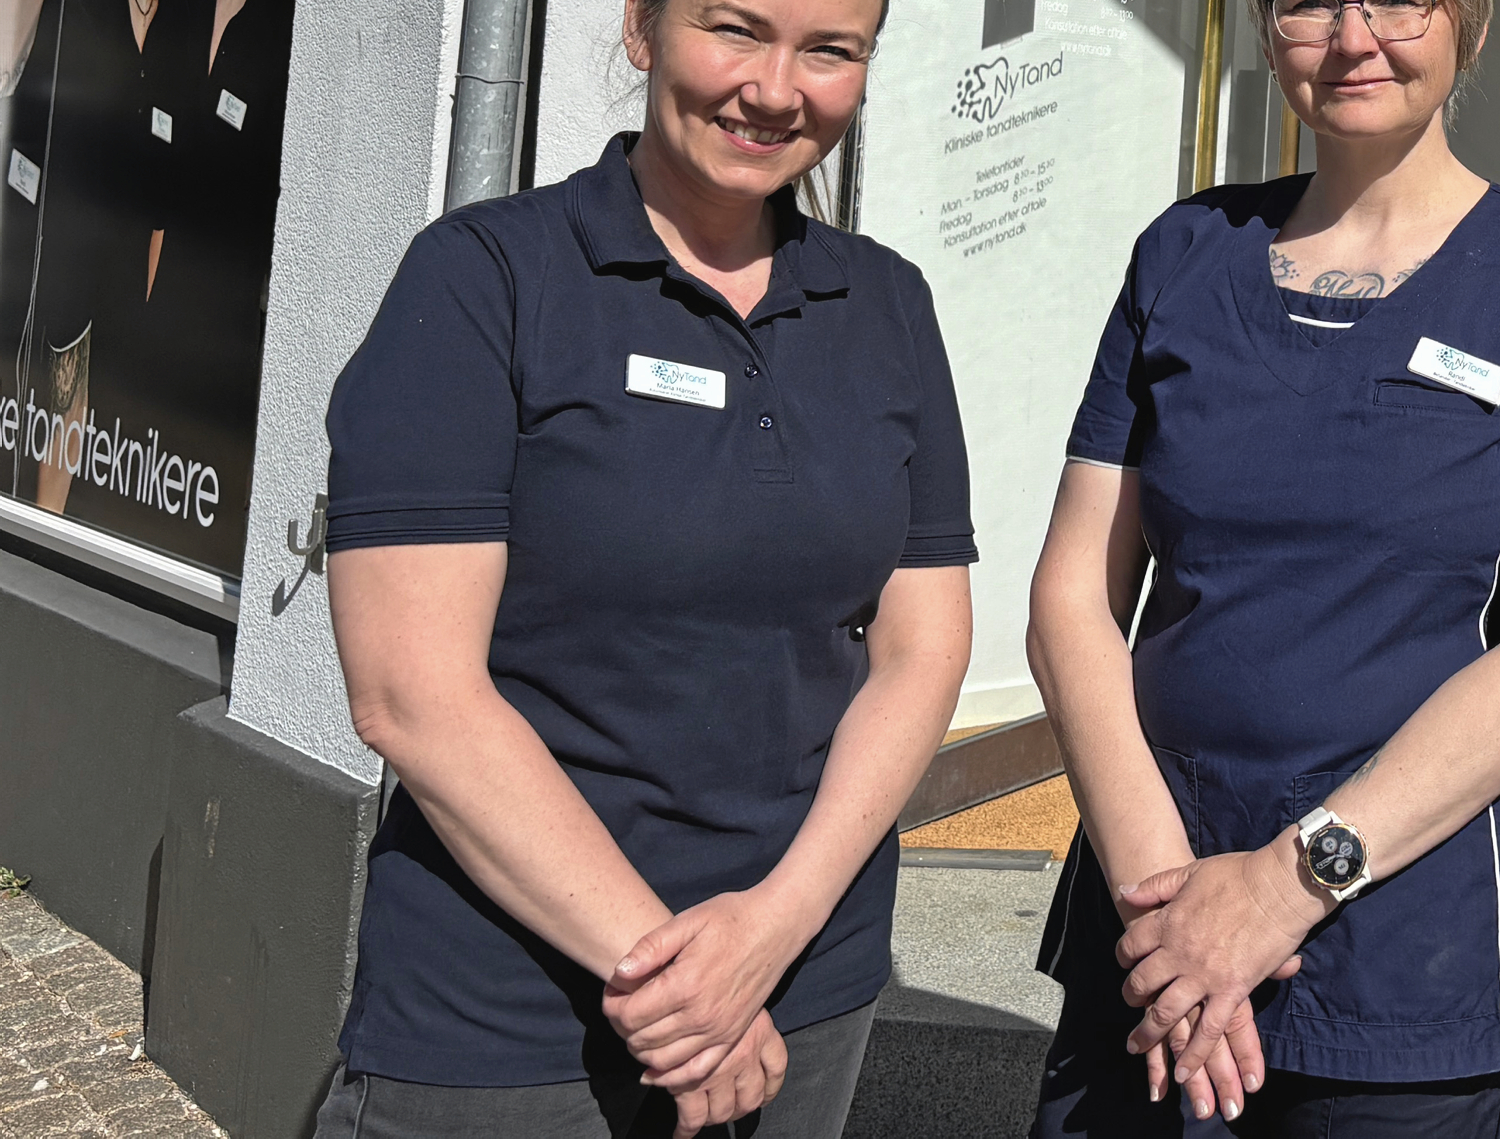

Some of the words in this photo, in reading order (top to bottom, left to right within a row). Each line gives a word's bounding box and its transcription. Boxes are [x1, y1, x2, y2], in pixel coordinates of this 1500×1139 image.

[994, 51, 1063, 99] NyTand
[944, 129, 984, 155] Kliniske
[986, 101, 1058, 139] tandteknikere
[671, 370, 707, 385] NyTand
[1454, 358, 1490, 377] NyTand
[24, 388, 220, 528] tandteknikere
